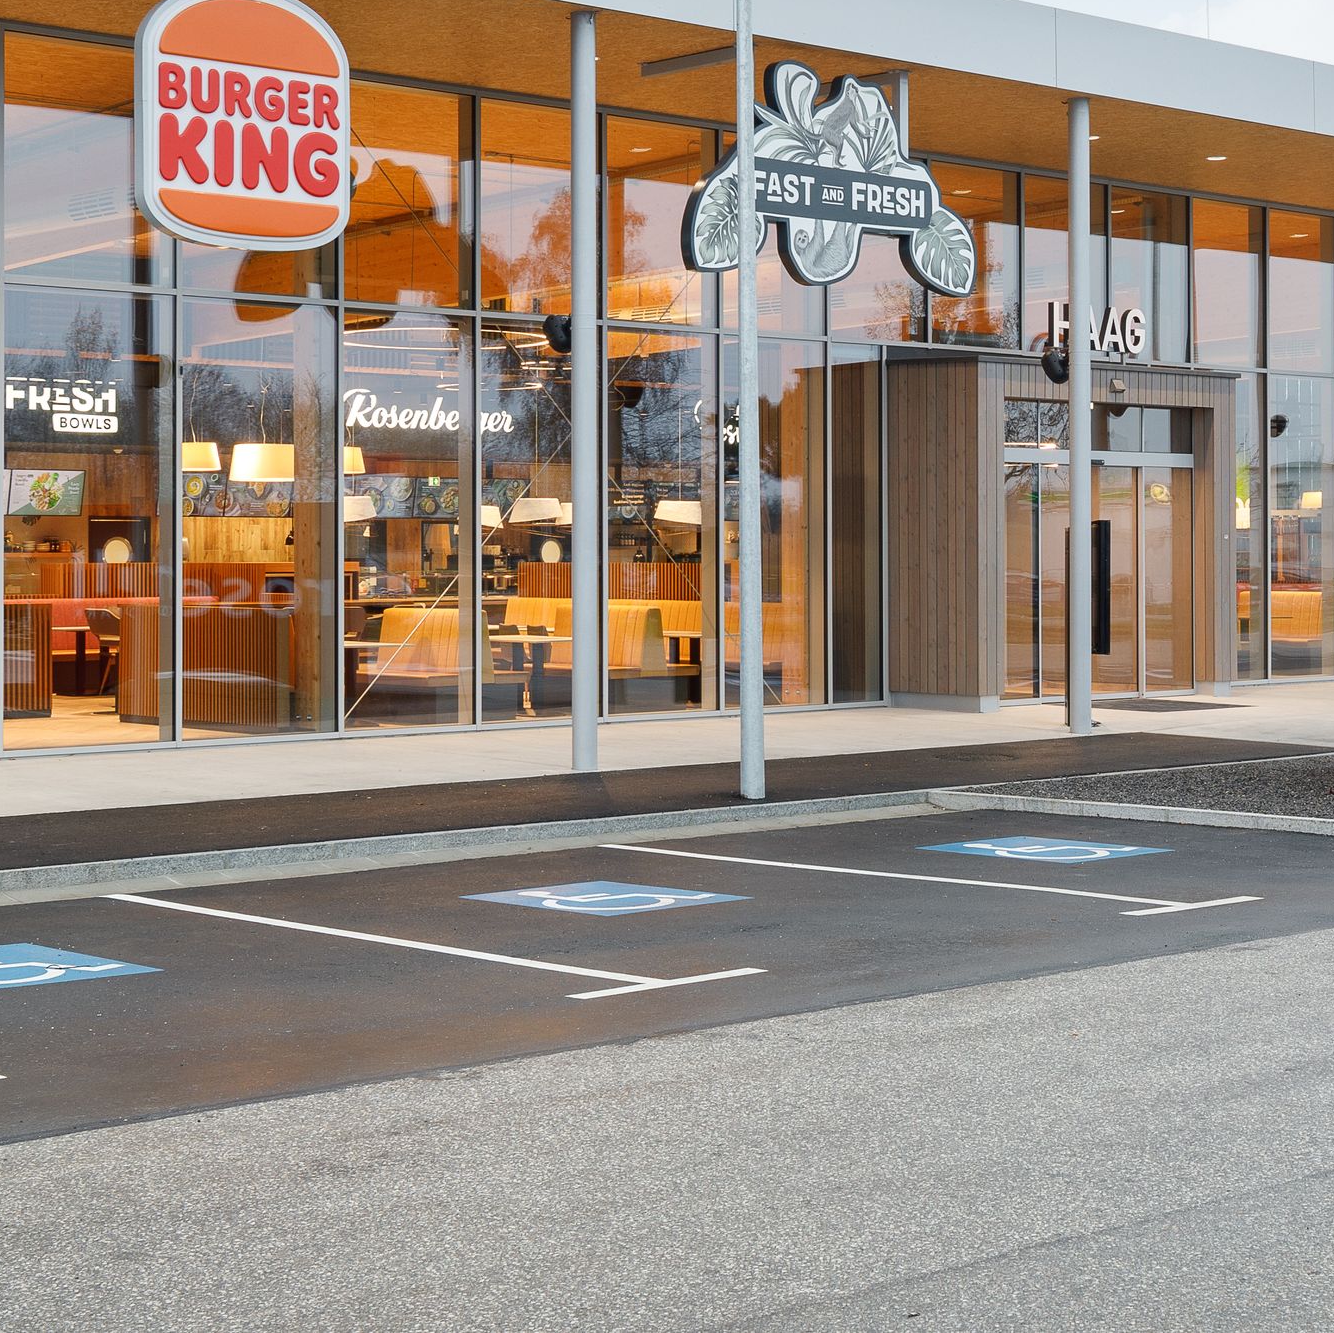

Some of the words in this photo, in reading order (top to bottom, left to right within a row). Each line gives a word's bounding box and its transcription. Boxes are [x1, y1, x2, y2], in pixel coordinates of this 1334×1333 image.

[158, 61, 340, 130] BURGER
[159, 112, 340, 197] KING
[755, 170, 815, 206] FAST
[822, 186, 844, 204] AND
[851, 181, 925, 218] FRESH
[5, 377, 117, 413] FRESH
[59, 417, 112, 430] BOWLS
